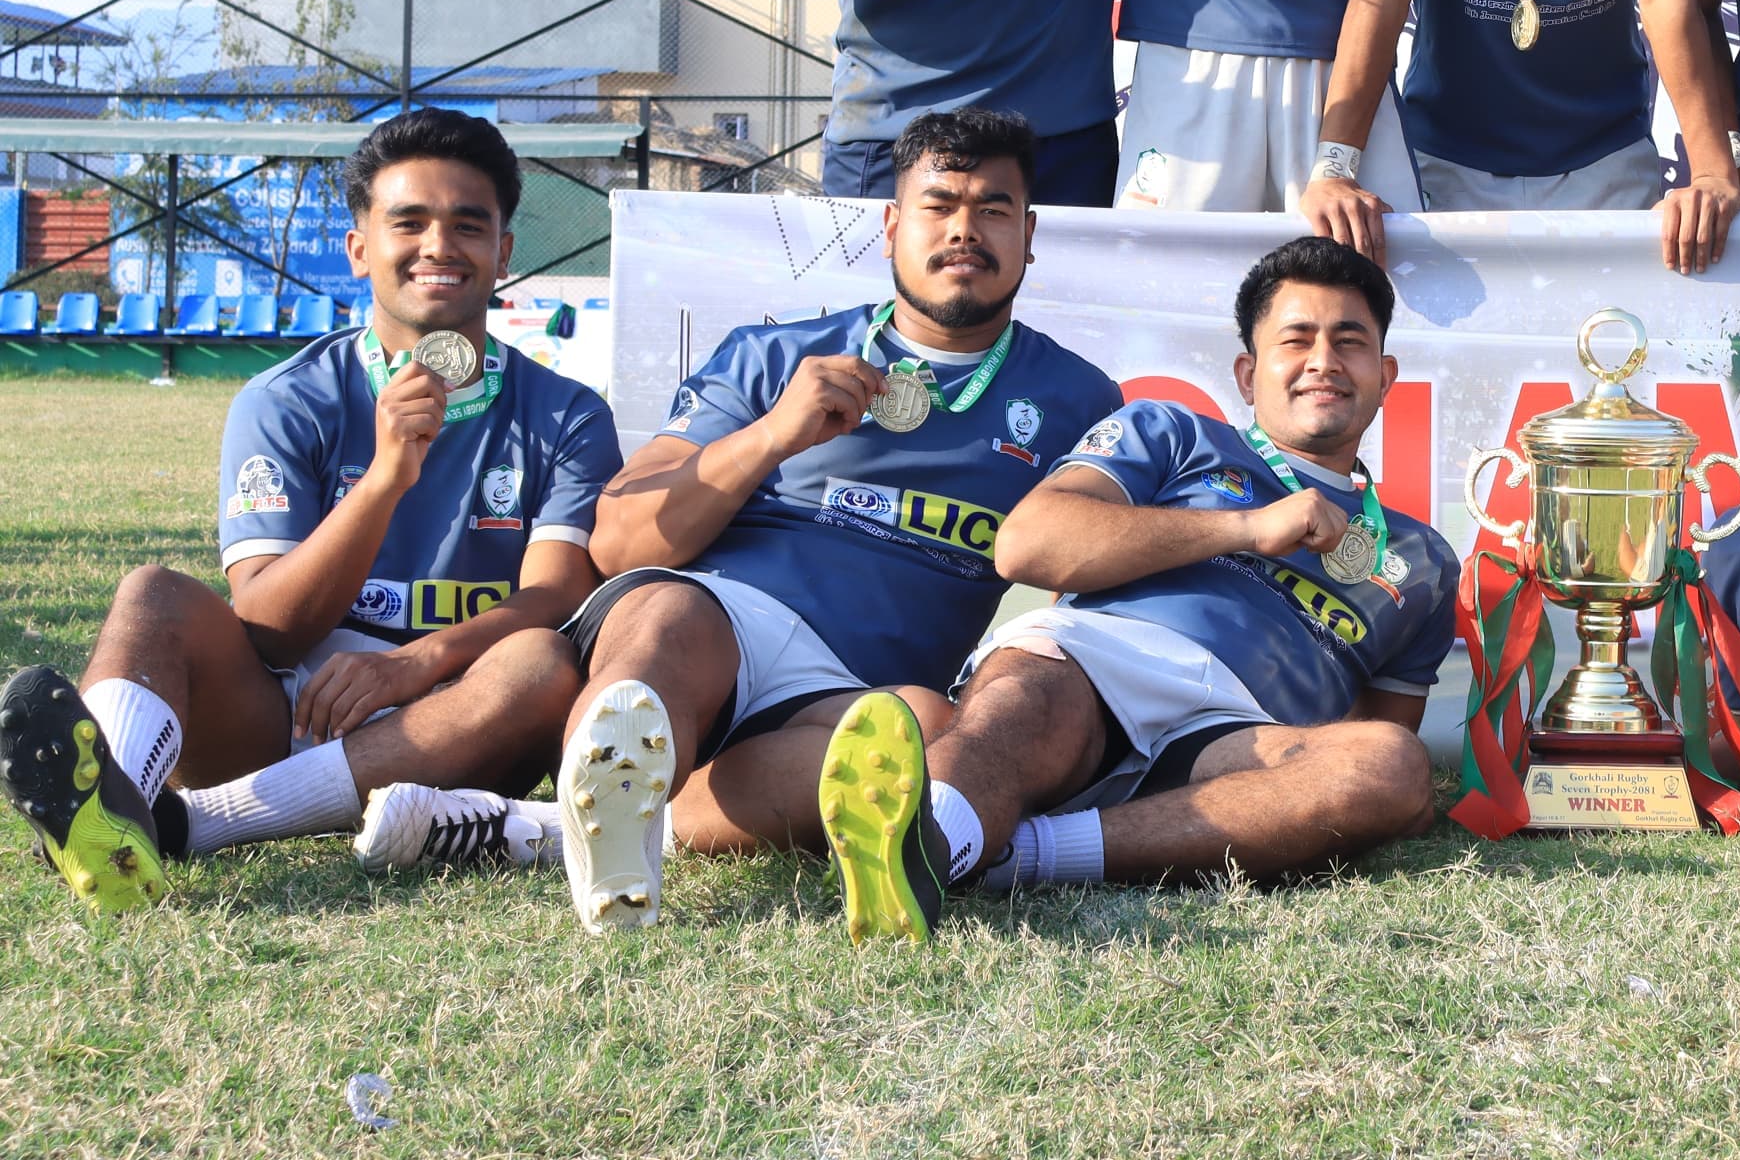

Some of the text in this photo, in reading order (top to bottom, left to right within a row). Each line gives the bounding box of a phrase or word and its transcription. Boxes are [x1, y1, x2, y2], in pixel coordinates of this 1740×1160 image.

[980, 356, 1000, 382] RUGBY
[961, 381, 984, 409] SEVEN
[908, 496, 999, 551] LIC
[421, 584, 504, 625] LIC
[1562, 785, 1656, 796] Seven Trophy-2081
[1570, 772, 1649, 785] Gorkhali Rugby
[1568, 797, 1647, 813] WINNER
